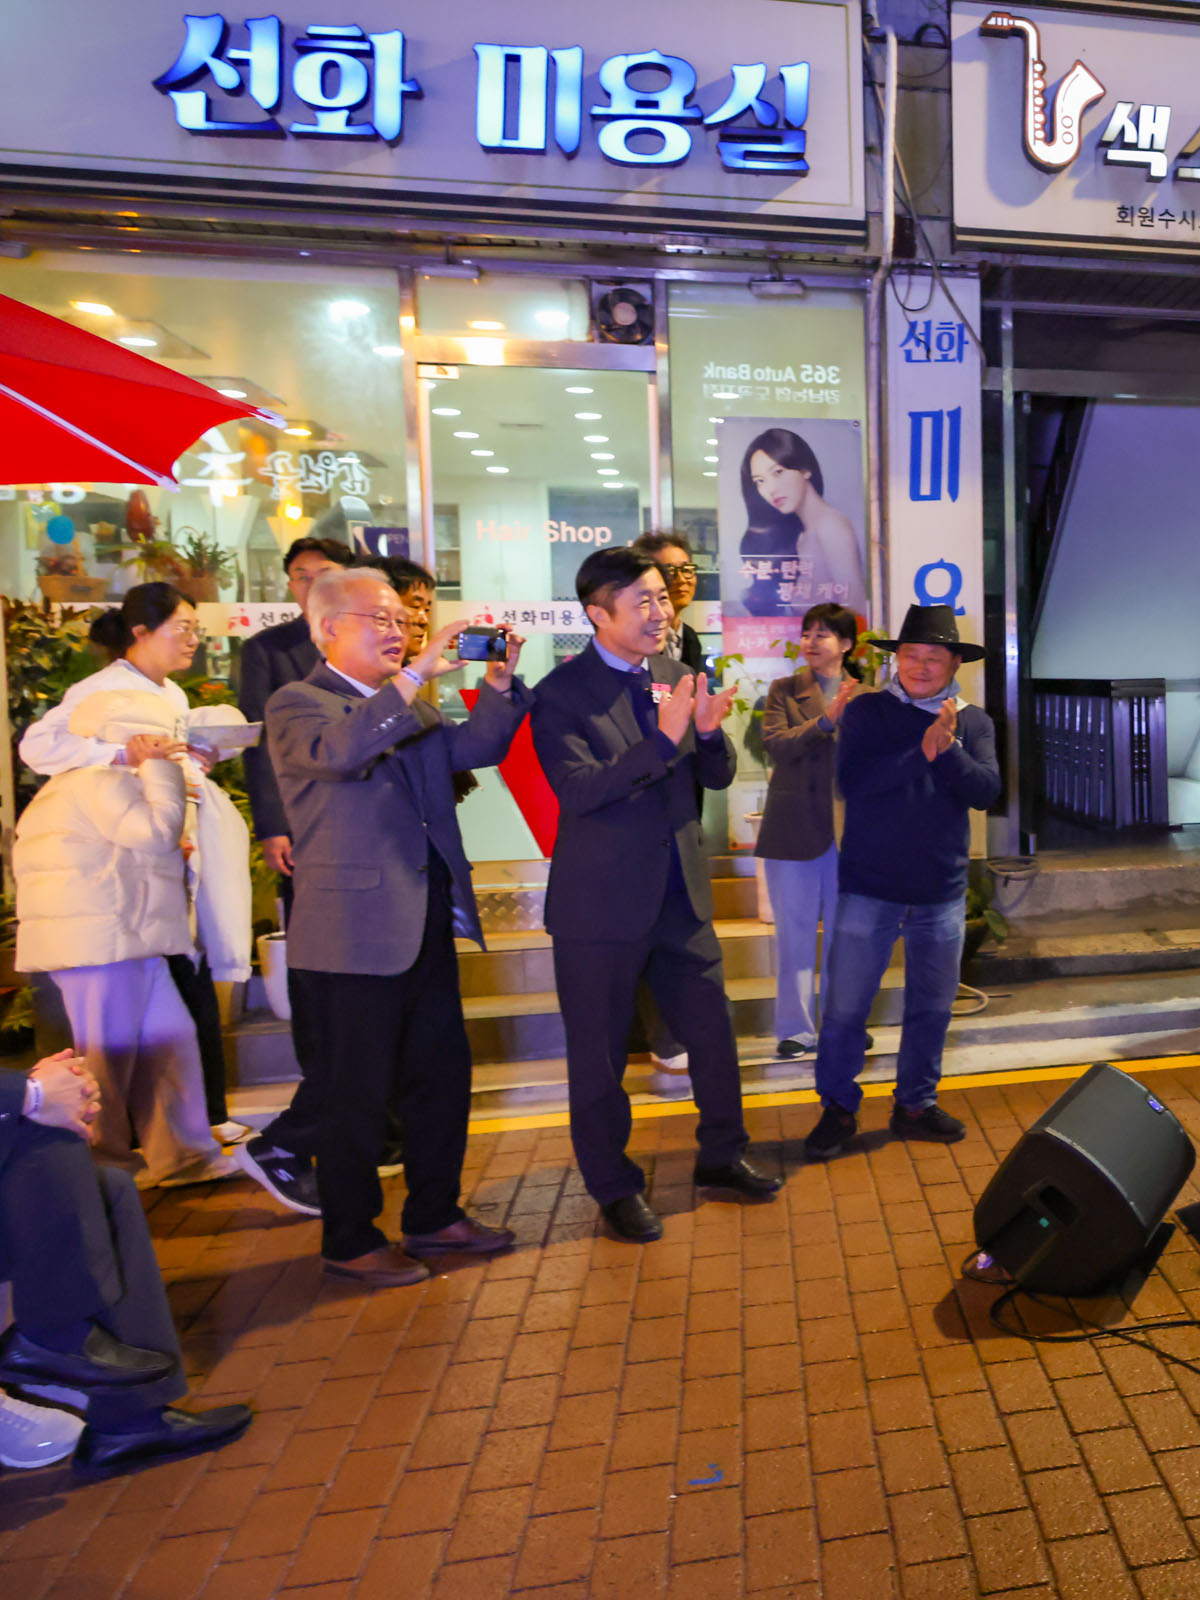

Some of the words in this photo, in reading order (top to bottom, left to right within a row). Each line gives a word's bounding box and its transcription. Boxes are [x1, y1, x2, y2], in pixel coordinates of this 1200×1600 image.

[153, 13, 424, 143] 선화
[473, 42, 812, 175] 미용실
[900, 320, 969, 363] 선화
[476, 520, 531, 541] Hair
[543, 520, 612, 547] Shop
